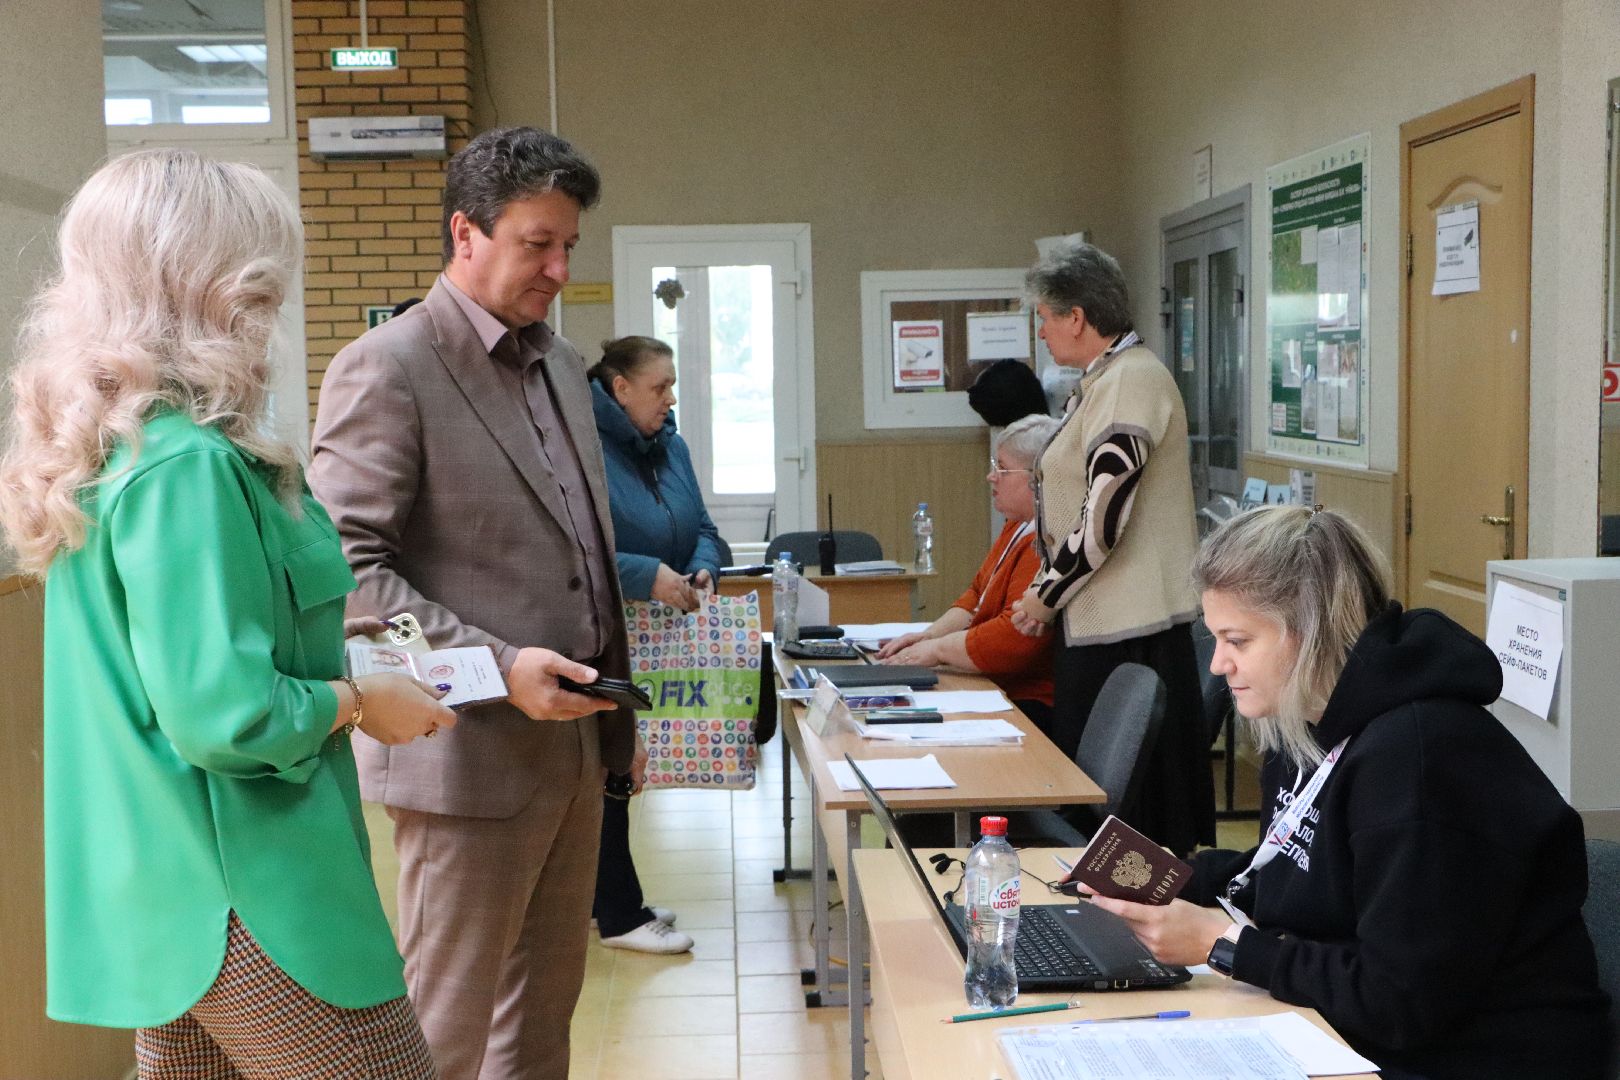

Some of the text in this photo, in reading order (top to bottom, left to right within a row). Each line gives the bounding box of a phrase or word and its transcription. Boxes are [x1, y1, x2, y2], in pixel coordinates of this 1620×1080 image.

[336, 51, 393, 66] ВЫХОД
[1516, 624, 1539, 641] МЕСТО
[1508, 639, 1543, 660] ХРАНЕНИЯ
[1498, 652, 1548, 680] СЕЙФ-ПАКЕТОВ
[659, 680, 709, 707] FIX
[1087, 831, 1118, 871] РОССИЙСКАЯ
[1094, 838, 1121, 872] ФЕДЕРАЦИЯ
